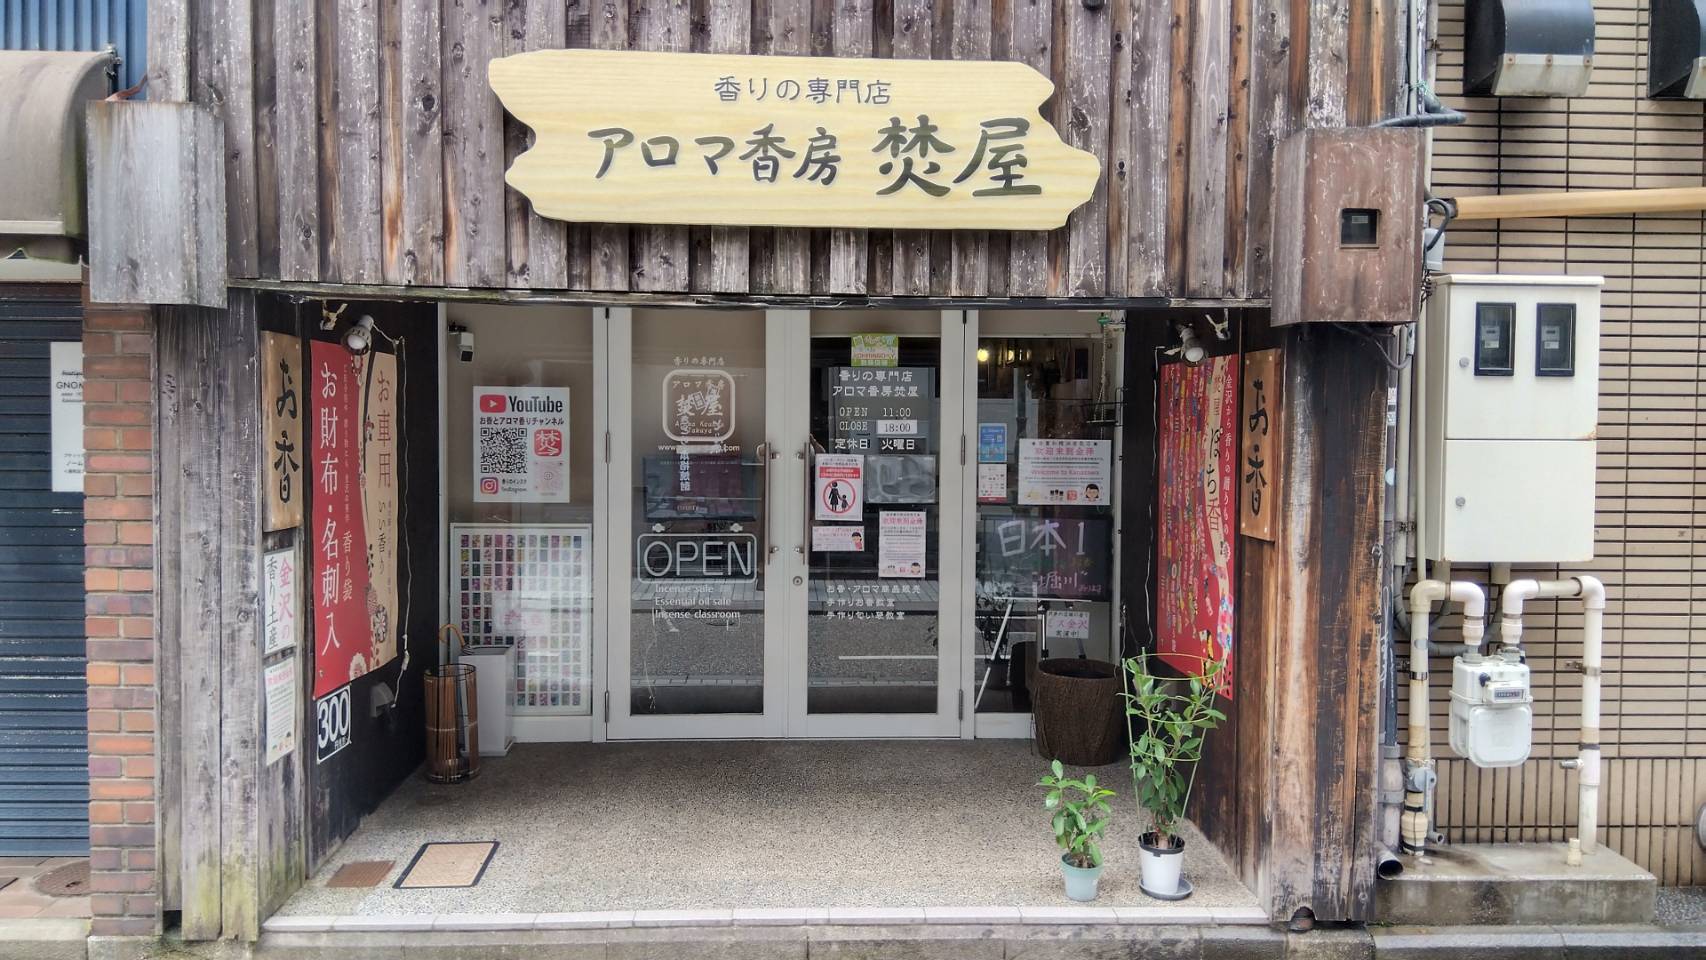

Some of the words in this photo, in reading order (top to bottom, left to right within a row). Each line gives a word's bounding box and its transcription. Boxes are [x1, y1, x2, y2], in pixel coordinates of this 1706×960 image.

[714, 76, 892, 105] 香りの専門店
[587, 123, 842, 186] アロマ香房
[871, 114, 1043, 198] 焚屋
[508, 395, 564, 413] YouTube
[840, 407, 868, 417] OPEN
[883, 407, 911, 417] 11:00
[273, 358, 300, 503] お香
[377, 370, 391, 489] お車用
[840, 421, 868, 431] CLOSE
[885, 423, 911, 433] 18:00
[834, 438, 869, 450] 定休日
[881, 438, 915, 450] 火曜日
[1246, 379, 1268, 516] お香
[320, 362, 340, 656] お財布・名刺入
[644, 541, 752, 577] OPEN
[655, 583, 691, 593] Incense
[713, 596, 731, 606] sale
[655, 609, 691, 619] Incense
[694, 609, 740, 619] classroom
[318, 691, 349, 748] 300
